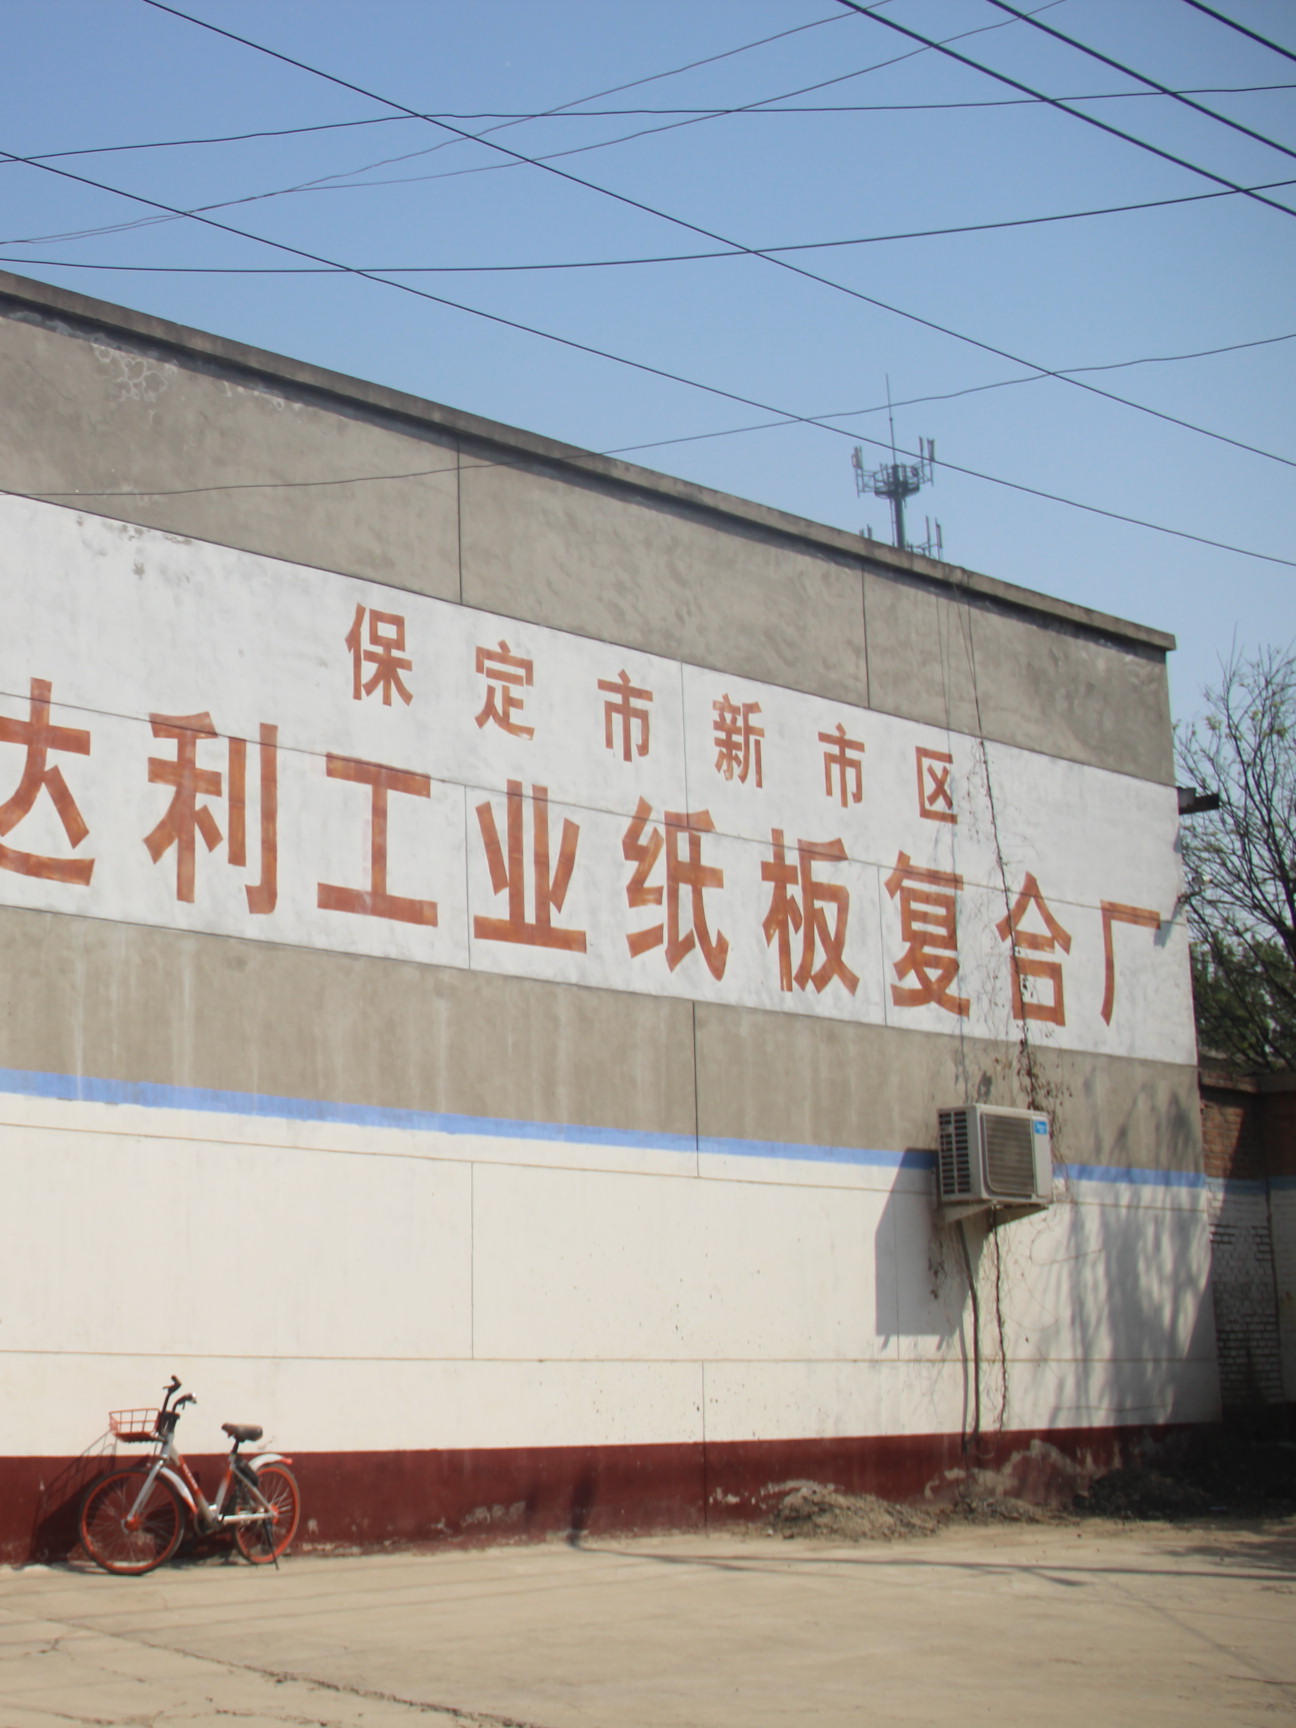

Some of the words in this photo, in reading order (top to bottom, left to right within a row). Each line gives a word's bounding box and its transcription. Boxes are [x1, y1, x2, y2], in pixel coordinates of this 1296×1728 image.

[345, 603, 958, 824] 保定市新市区
